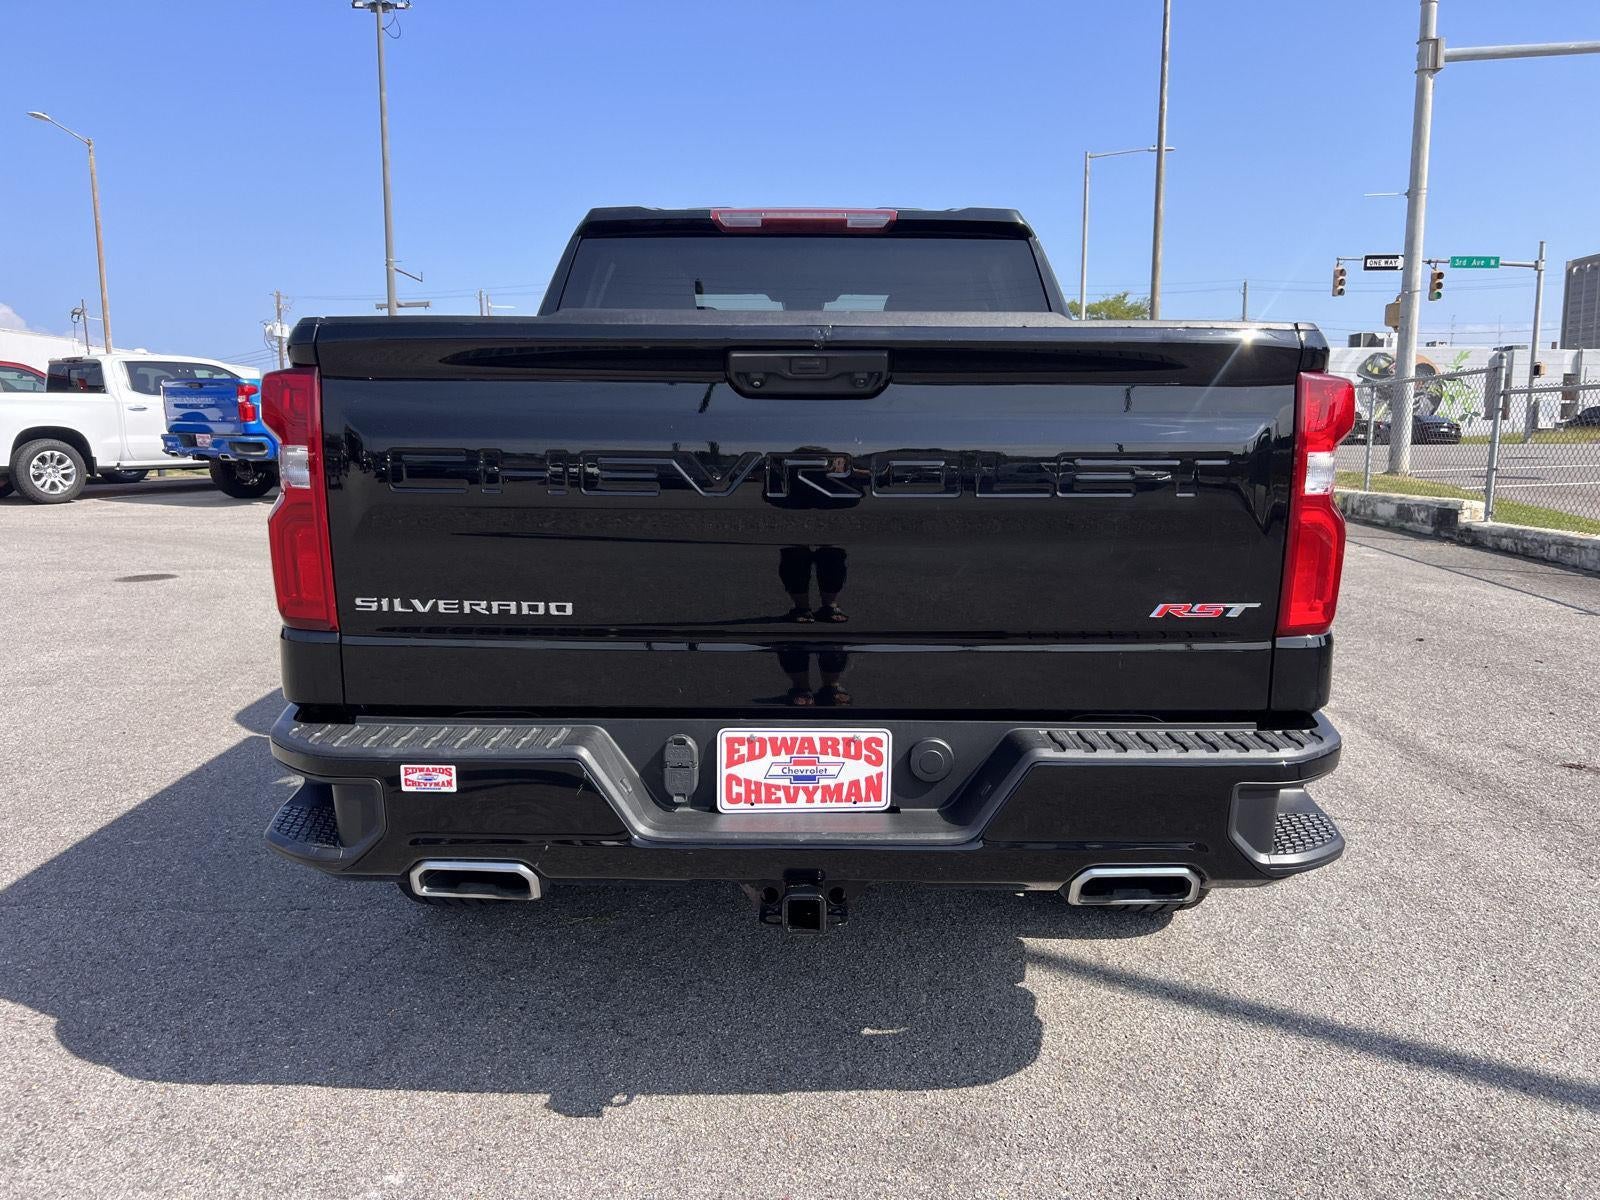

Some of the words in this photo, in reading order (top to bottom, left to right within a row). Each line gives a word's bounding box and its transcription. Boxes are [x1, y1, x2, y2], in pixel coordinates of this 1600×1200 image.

[1454, 258, 1467, 266] 3rd
[1471, 258, 1485, 266] Ave
[1490, 258, 1496, 266] N
[387, 448, 1232, 498] CHEVROLET
[354, 597, 574, 616] SILVERADO
[1149, 602, 1262, 618] RST
[725, 736, 884, 769] EDWARDS
[404, 766, 453, 777] EDWARDS
[781, 766, 828, 775] Chevrolet
[404, 777, 453, 788] CHEVYMAN
[725, 771, 884, 805] CHEVYMAN
